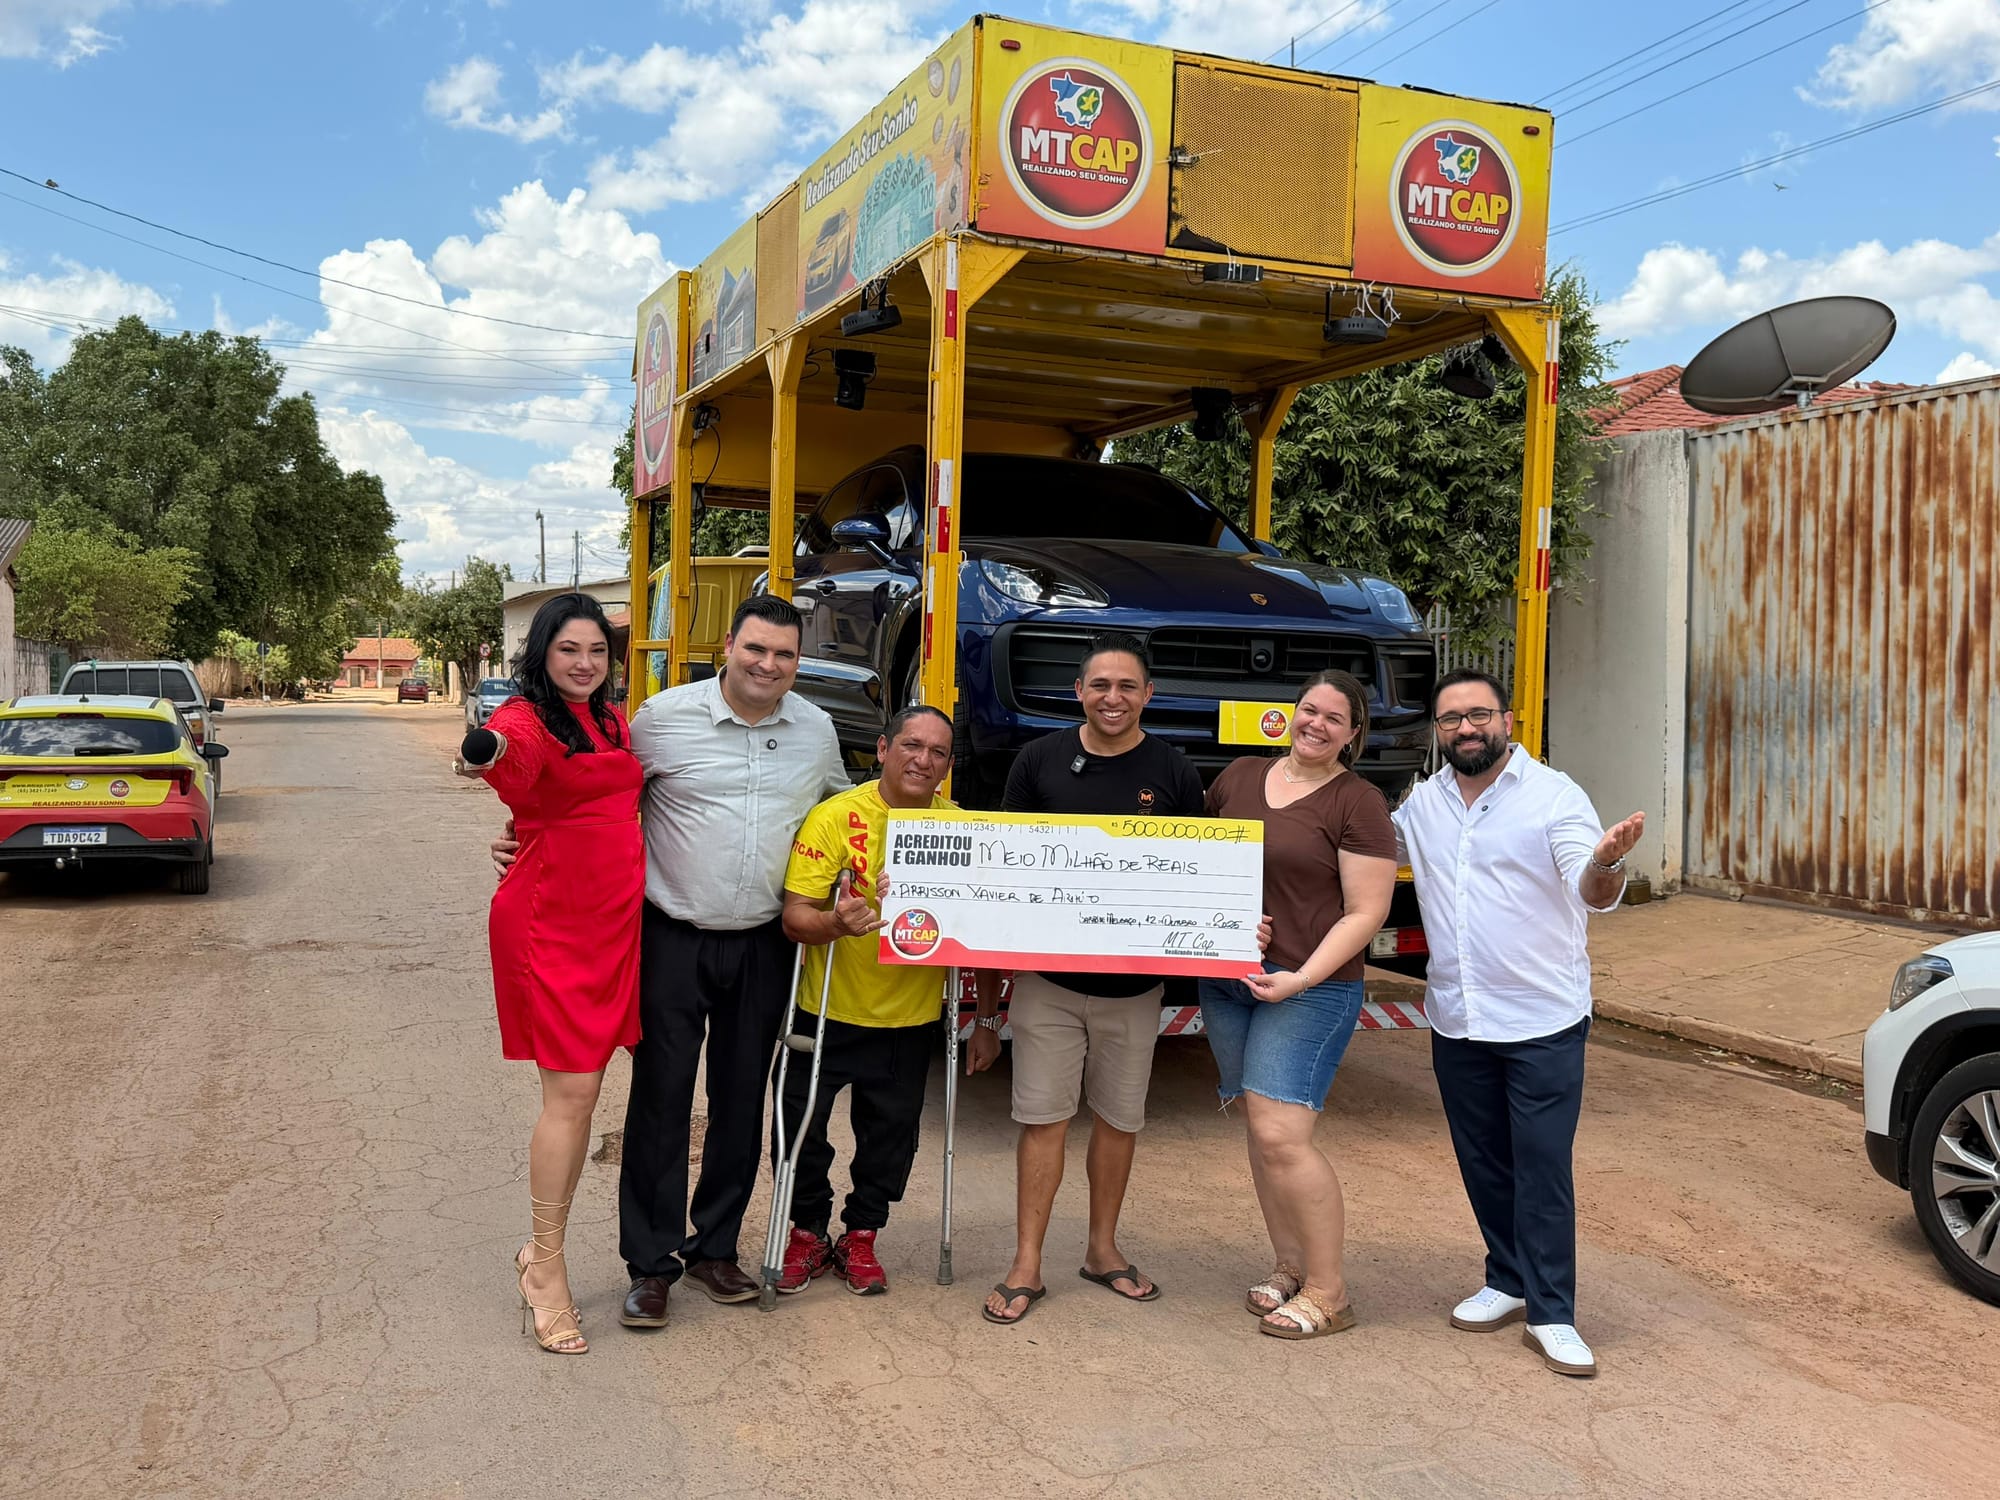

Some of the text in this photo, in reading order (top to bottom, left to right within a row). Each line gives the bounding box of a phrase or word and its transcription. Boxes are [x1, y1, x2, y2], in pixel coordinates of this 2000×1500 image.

[805, 143, 860, 212] Realizando
[860, 131, 880, 167] Seu
[880, 95, 917, 150] Sonho
[1021, 126, 1139, 173] MTCAP
[1022, 162, 1128, 185] REALIZANDO SEU SONHO
[919, 181, 934, 213] 100
[1407, 182, 1509, 226] MTCAP
[1408, 216, 1500, 236] REALIZANDO SEU SONHO
[644, 370, 671, 420] MTCAP
[1263, 721, 1286, 729] MTCAP
[895, 820, 906, 829] 01
[920, 821, 935, 830] 123
[944, 822, 951, 830] 0
[962, 823, 996, 832] 012345
[1028, 826, 1055, 834] 54321
[793, 840, 825, 861] TCAP
[894, 833, 972, 850] ACREDITOU
[848, 811, 869, 898] TCAP
[892, 850, 972, 867] E GANHOU
[979, 840, 1199, 875] MEIO MILHÃO DE REAIS
[966, 884, 1020, 902] XAVIER
[1029, 893, 1044, 904] DE
[895, 928, 938, 941] MTCAP
[1162, 930, 1215, 952] MT Cap
